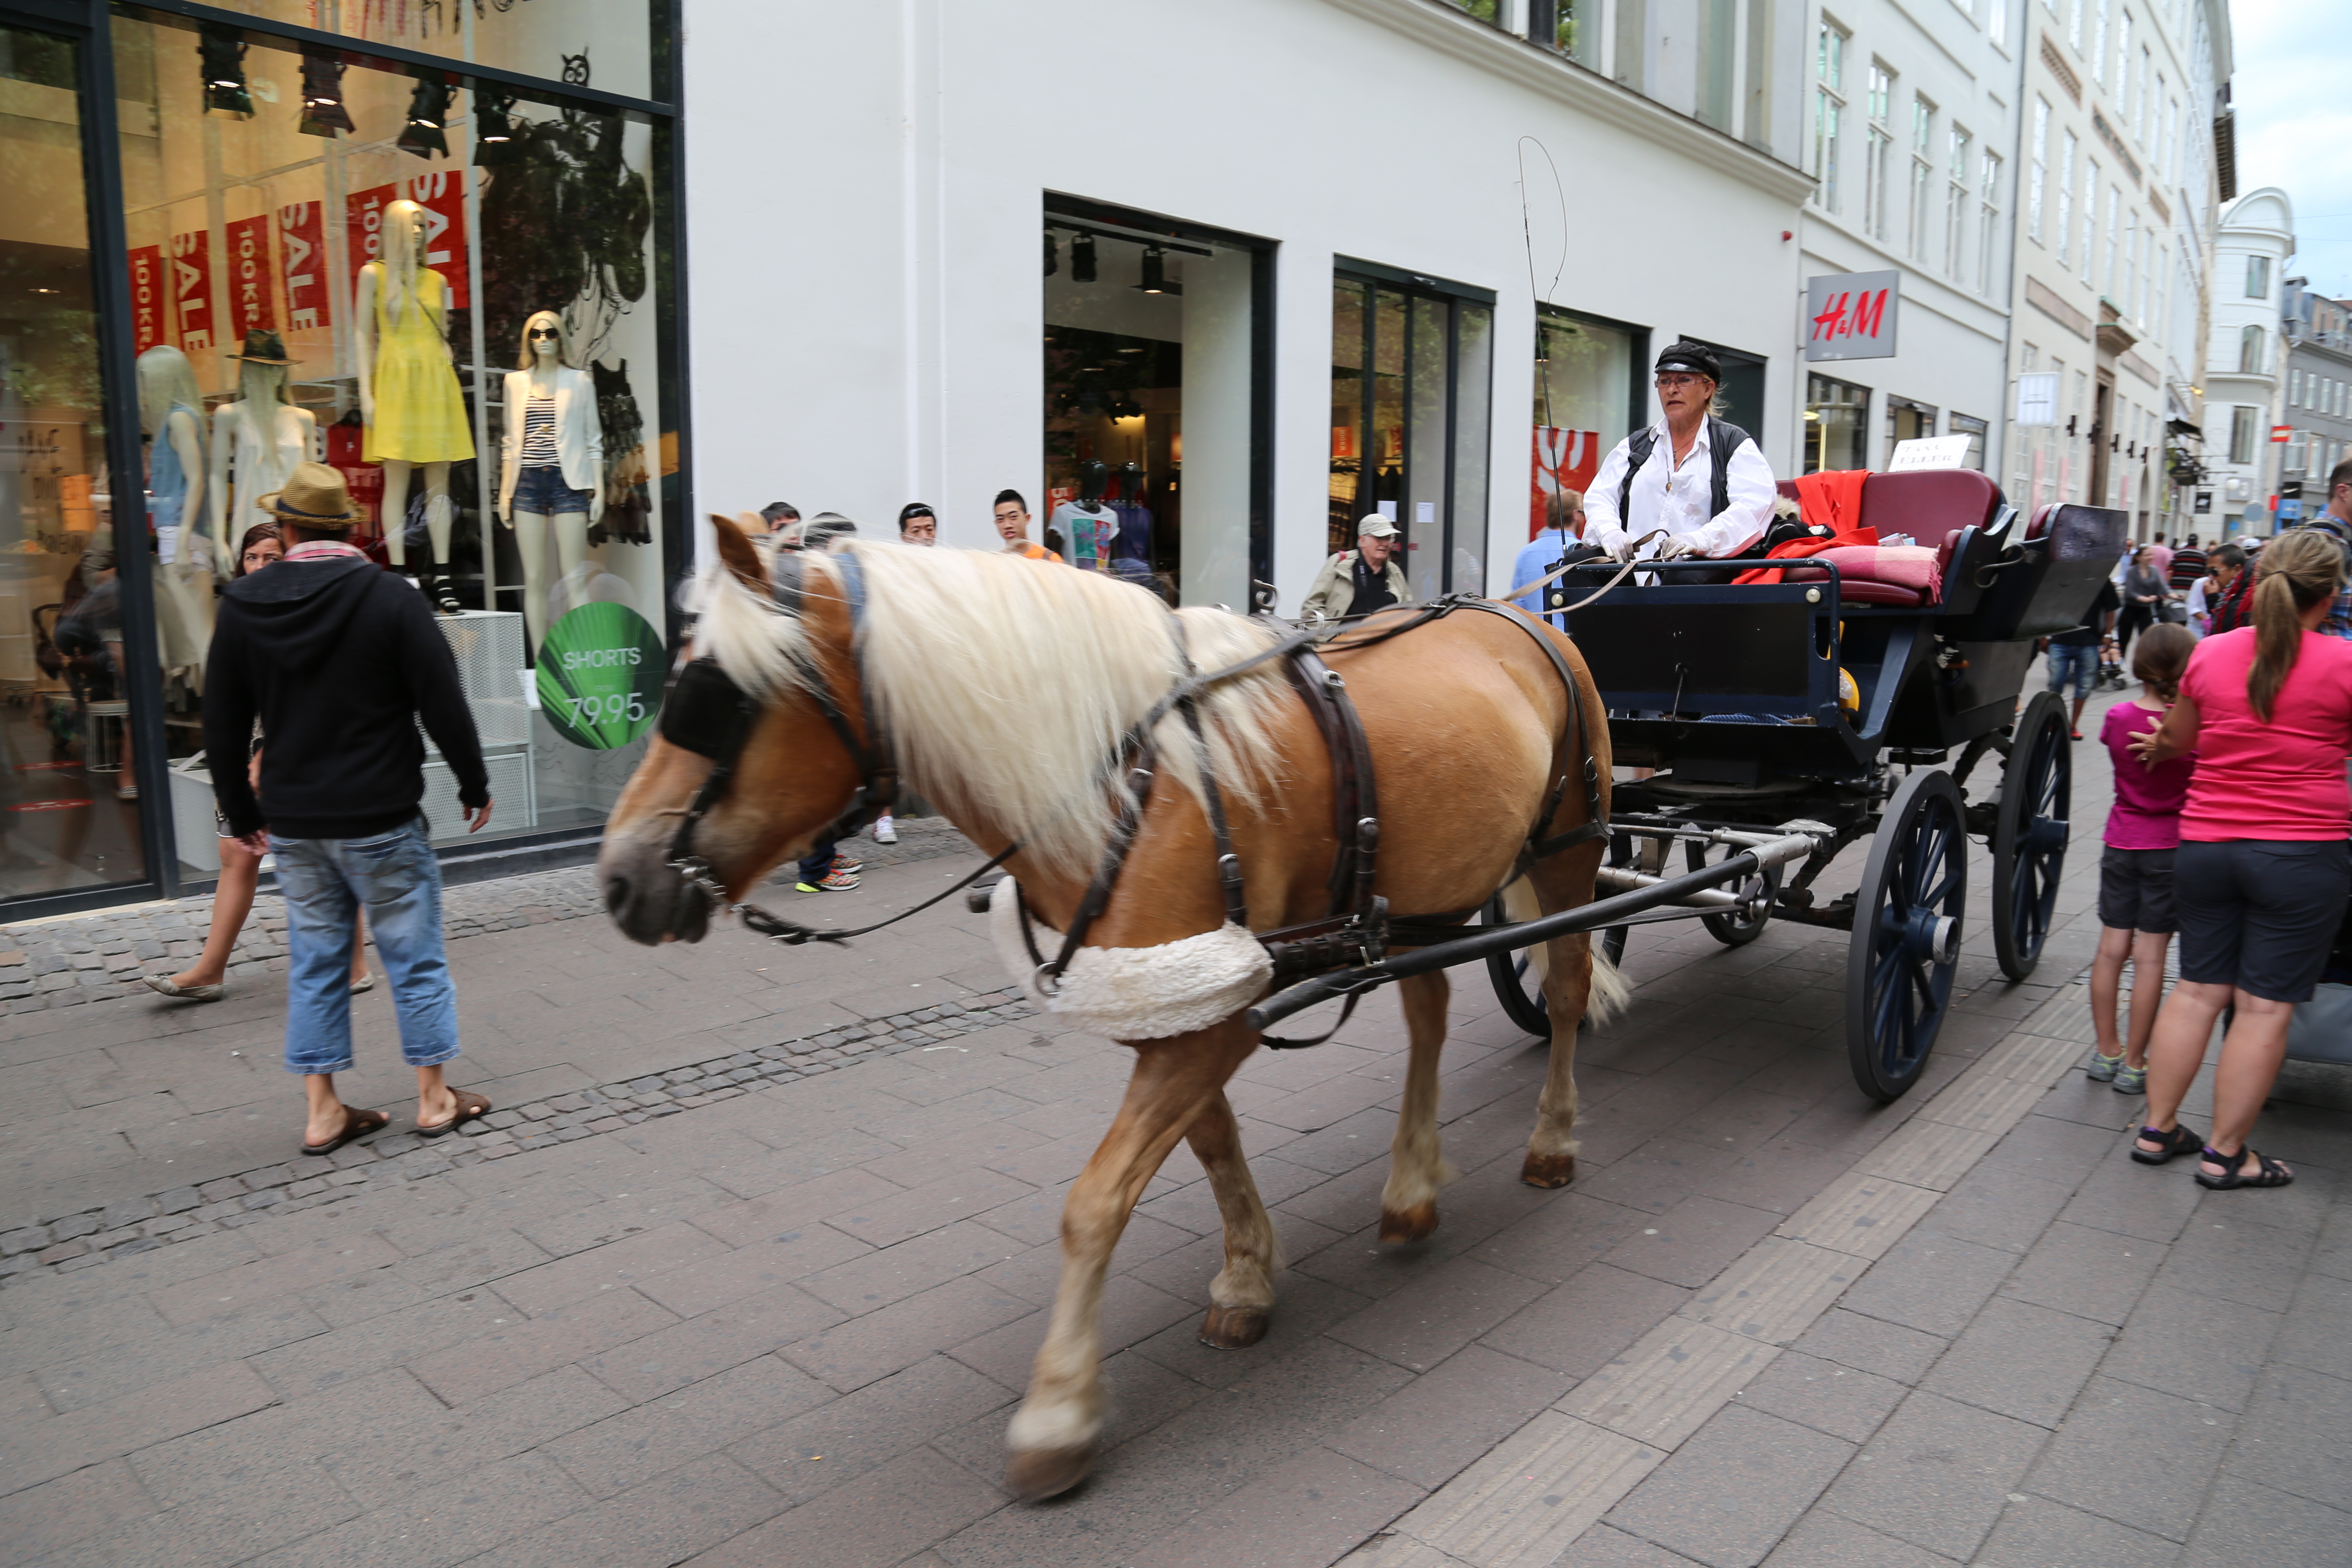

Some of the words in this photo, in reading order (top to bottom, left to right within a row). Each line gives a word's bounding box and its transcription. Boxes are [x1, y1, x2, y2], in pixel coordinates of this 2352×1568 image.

[172, 231, 210, 352] SALE
[280, 202, 318, 331] SALE
[135, 254, 153, 350] 100KR.
[1812, 288, 1890, 341] H&M
[1899, 455, 1953, 464] ELLER
[563, 647, 642, 670] SHORTS
[564, 692, 645, 728] 79.95
